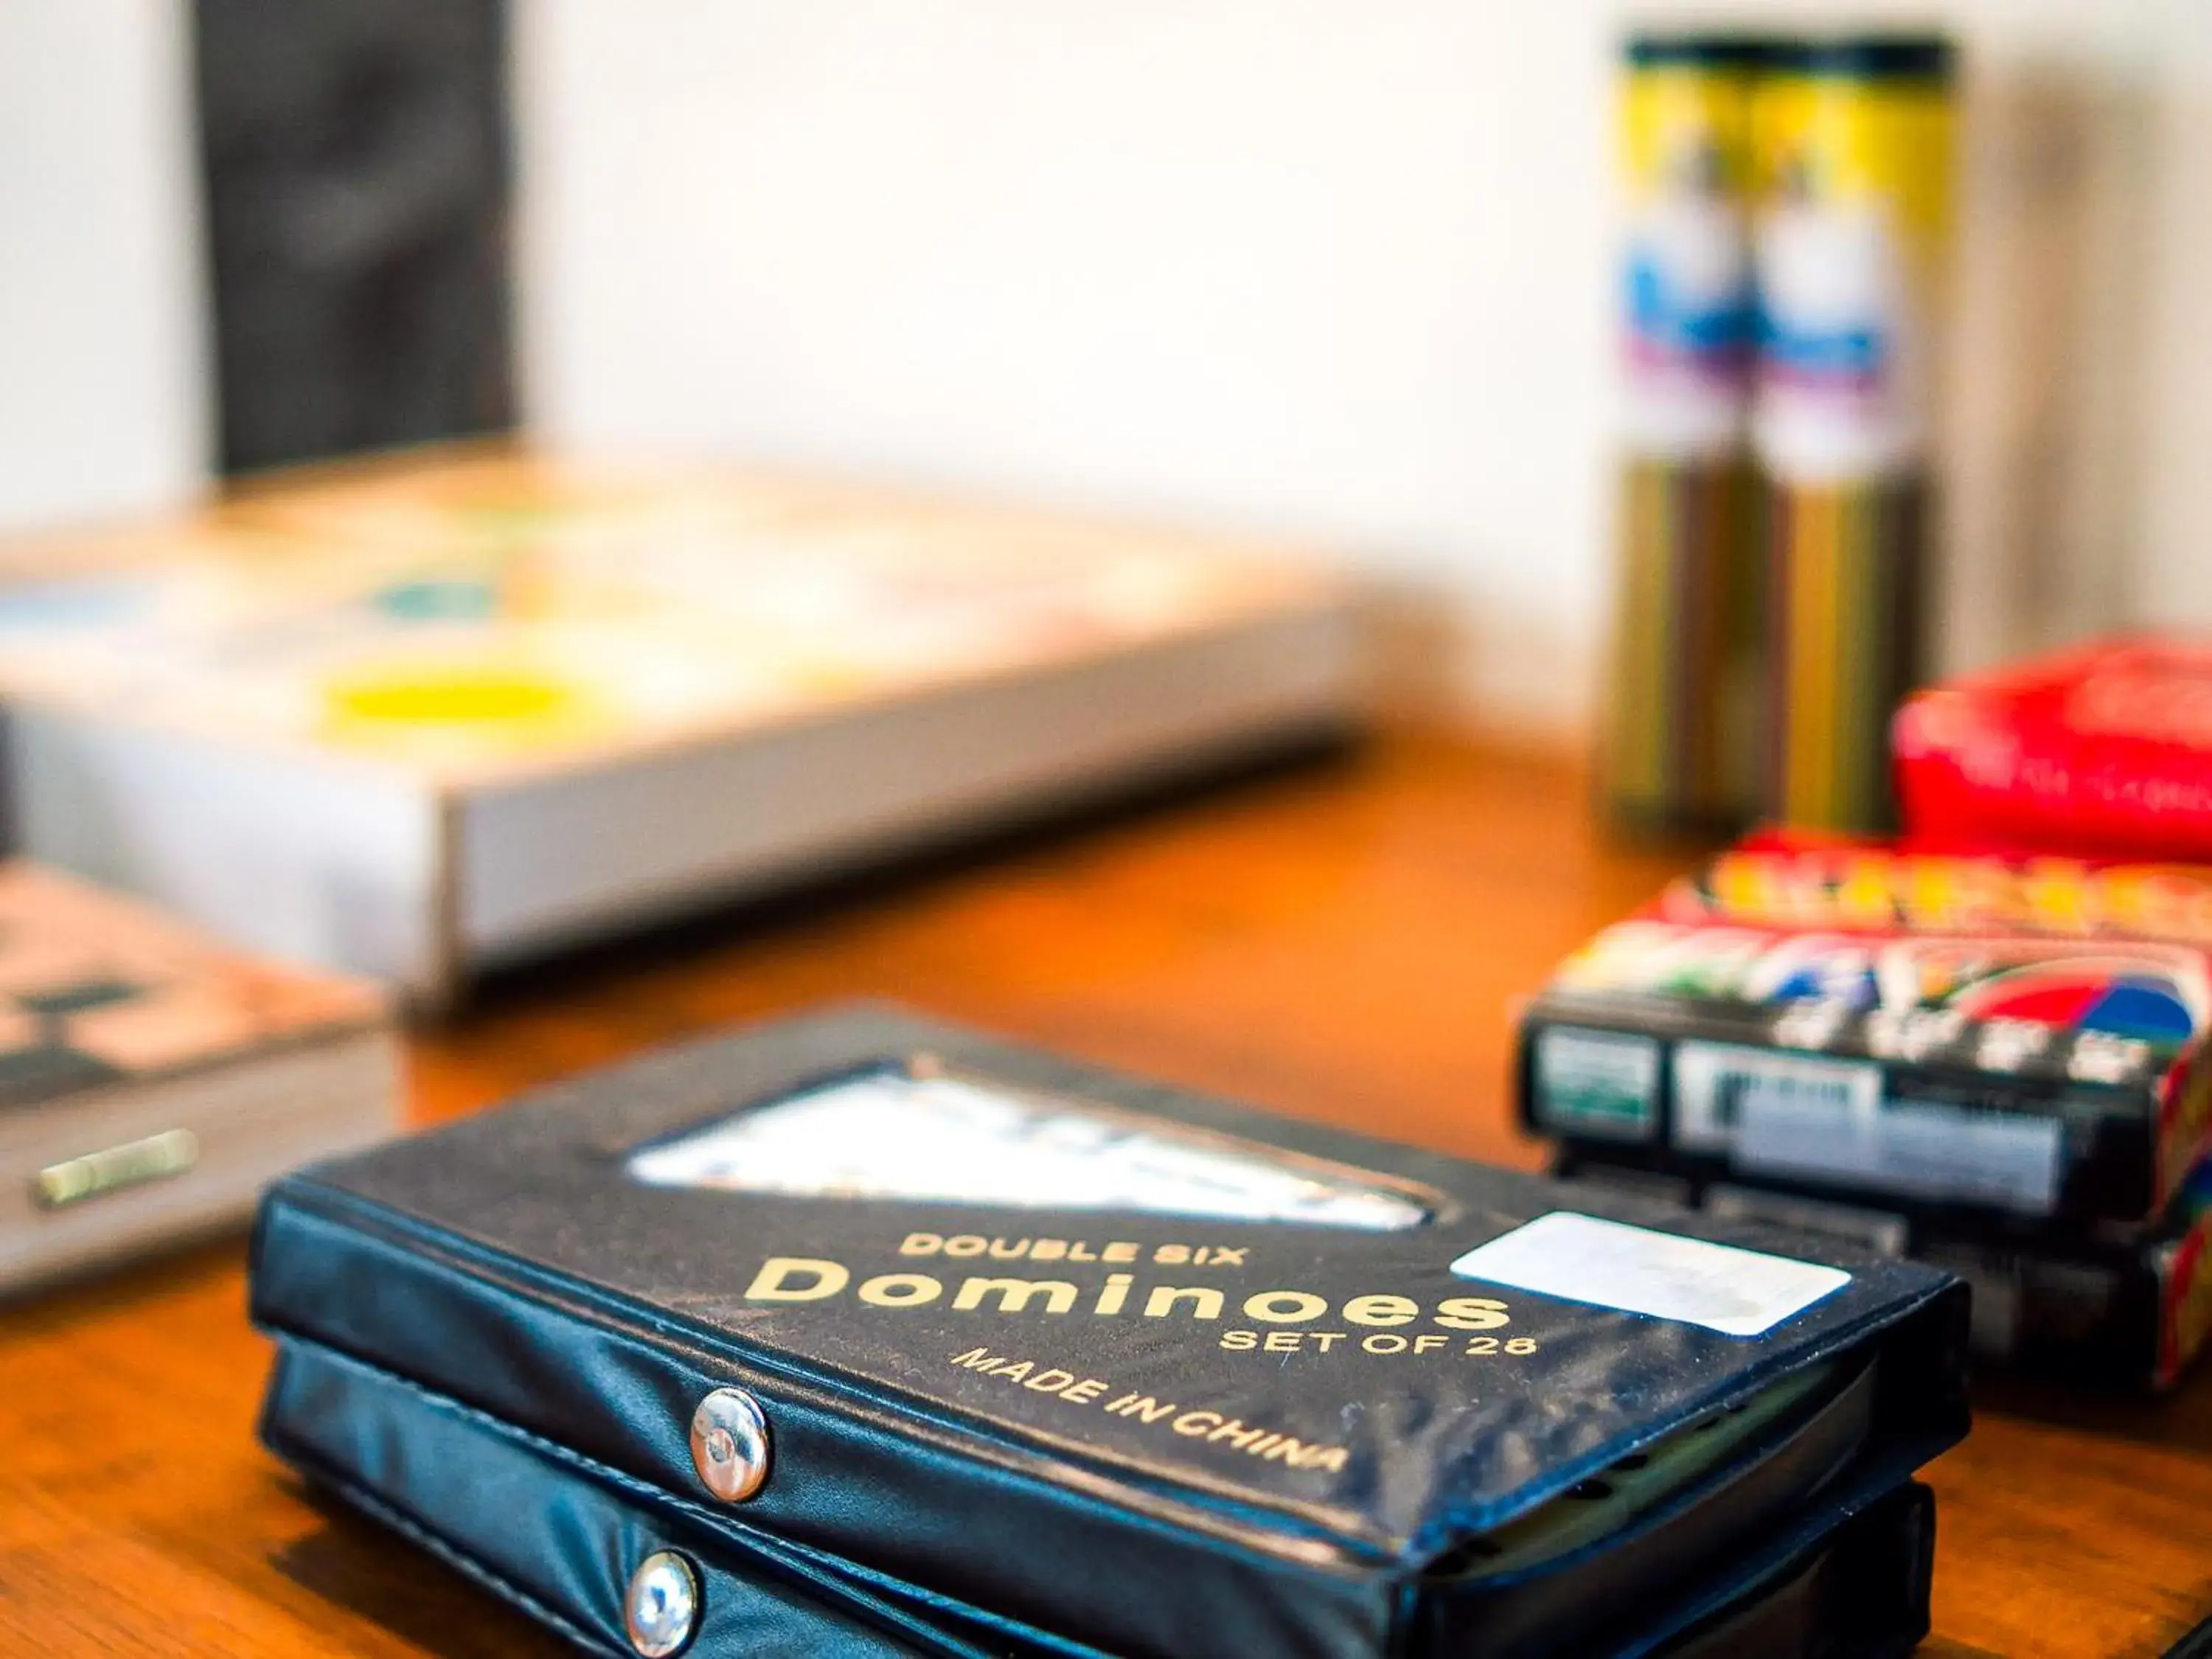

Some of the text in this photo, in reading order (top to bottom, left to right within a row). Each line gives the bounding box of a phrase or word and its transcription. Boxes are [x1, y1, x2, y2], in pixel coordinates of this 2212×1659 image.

[899, 1233, 1250, 1266] DOUBLE SIX
[743, 1256, 1512, 1329] Dominoes
[1219, 1330, 1538, 1356] SET OF 28
[950, 1347, 1350, 1473] MADE IN CHINA
